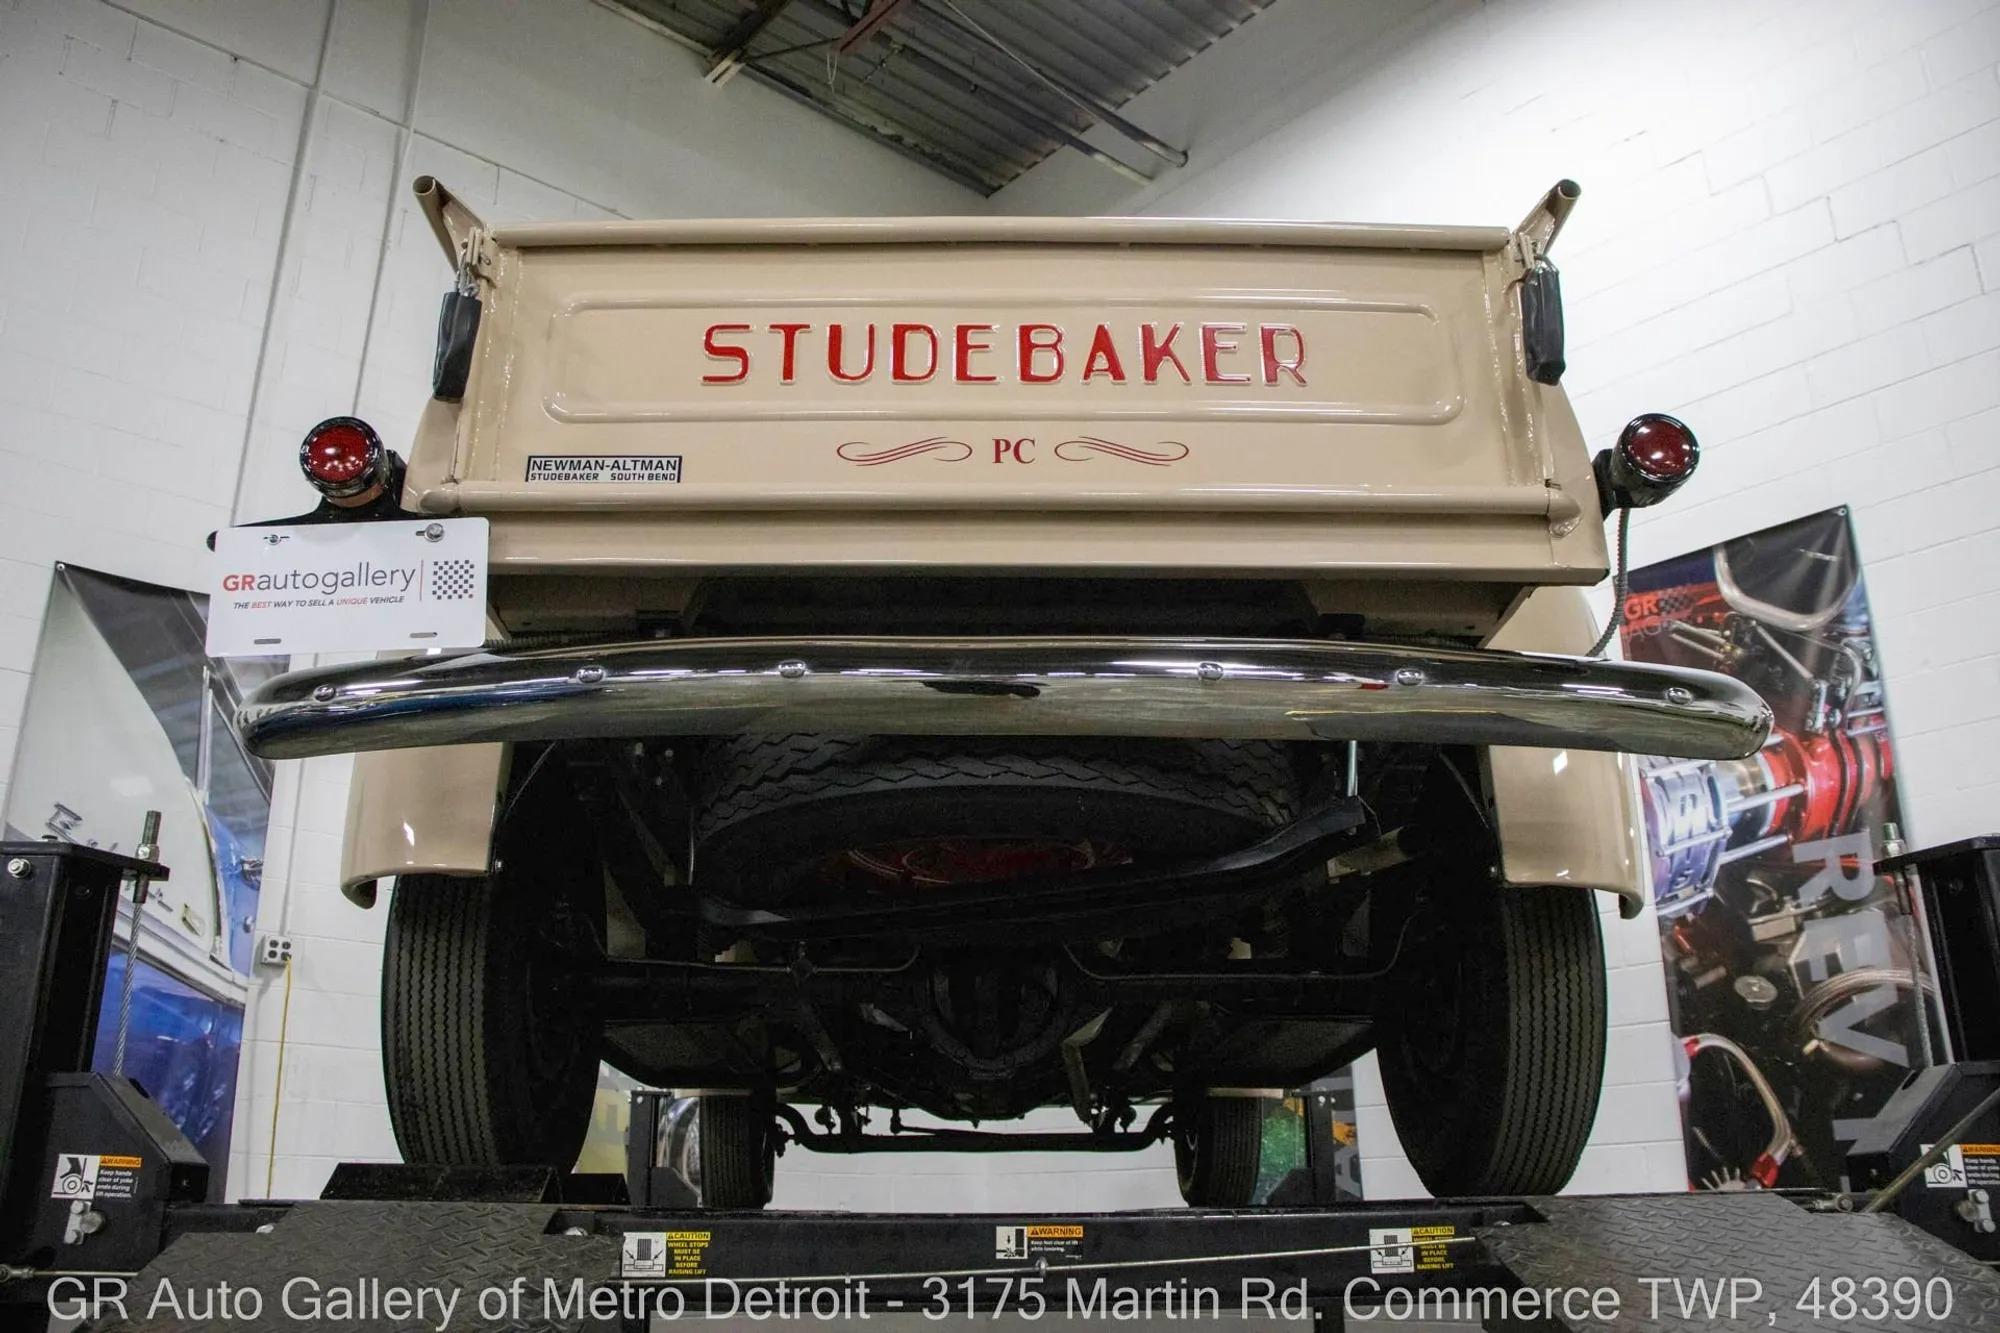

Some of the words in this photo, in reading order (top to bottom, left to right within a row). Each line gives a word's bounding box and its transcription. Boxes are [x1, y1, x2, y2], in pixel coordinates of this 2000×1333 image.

[701, 321, 1309, 386] STUDEBAKER
[993, 438, 1036, 465] PC
[532, 460, 677, 471] NEWMAN-ALTMAN
[531, 473, 599, 481] STUDEBAKER
[611, 473, 645, 481] SOUTH
[648, 473, 676, 481] BEND
[223, 562, 416, 595] GRautogallery
[251, 601, 271, 609] BEST
[274, 600, 291, 608] WAY
[337, 597, 367, 605] UNIQUE
[370, 596, 405, 604] VEHICLE
[107, 1158, 140, 1166] WARNING
[1040, 1227, 1082, 1235] WARNING
[1419, 1227, 1453, 1235] CAUTION
